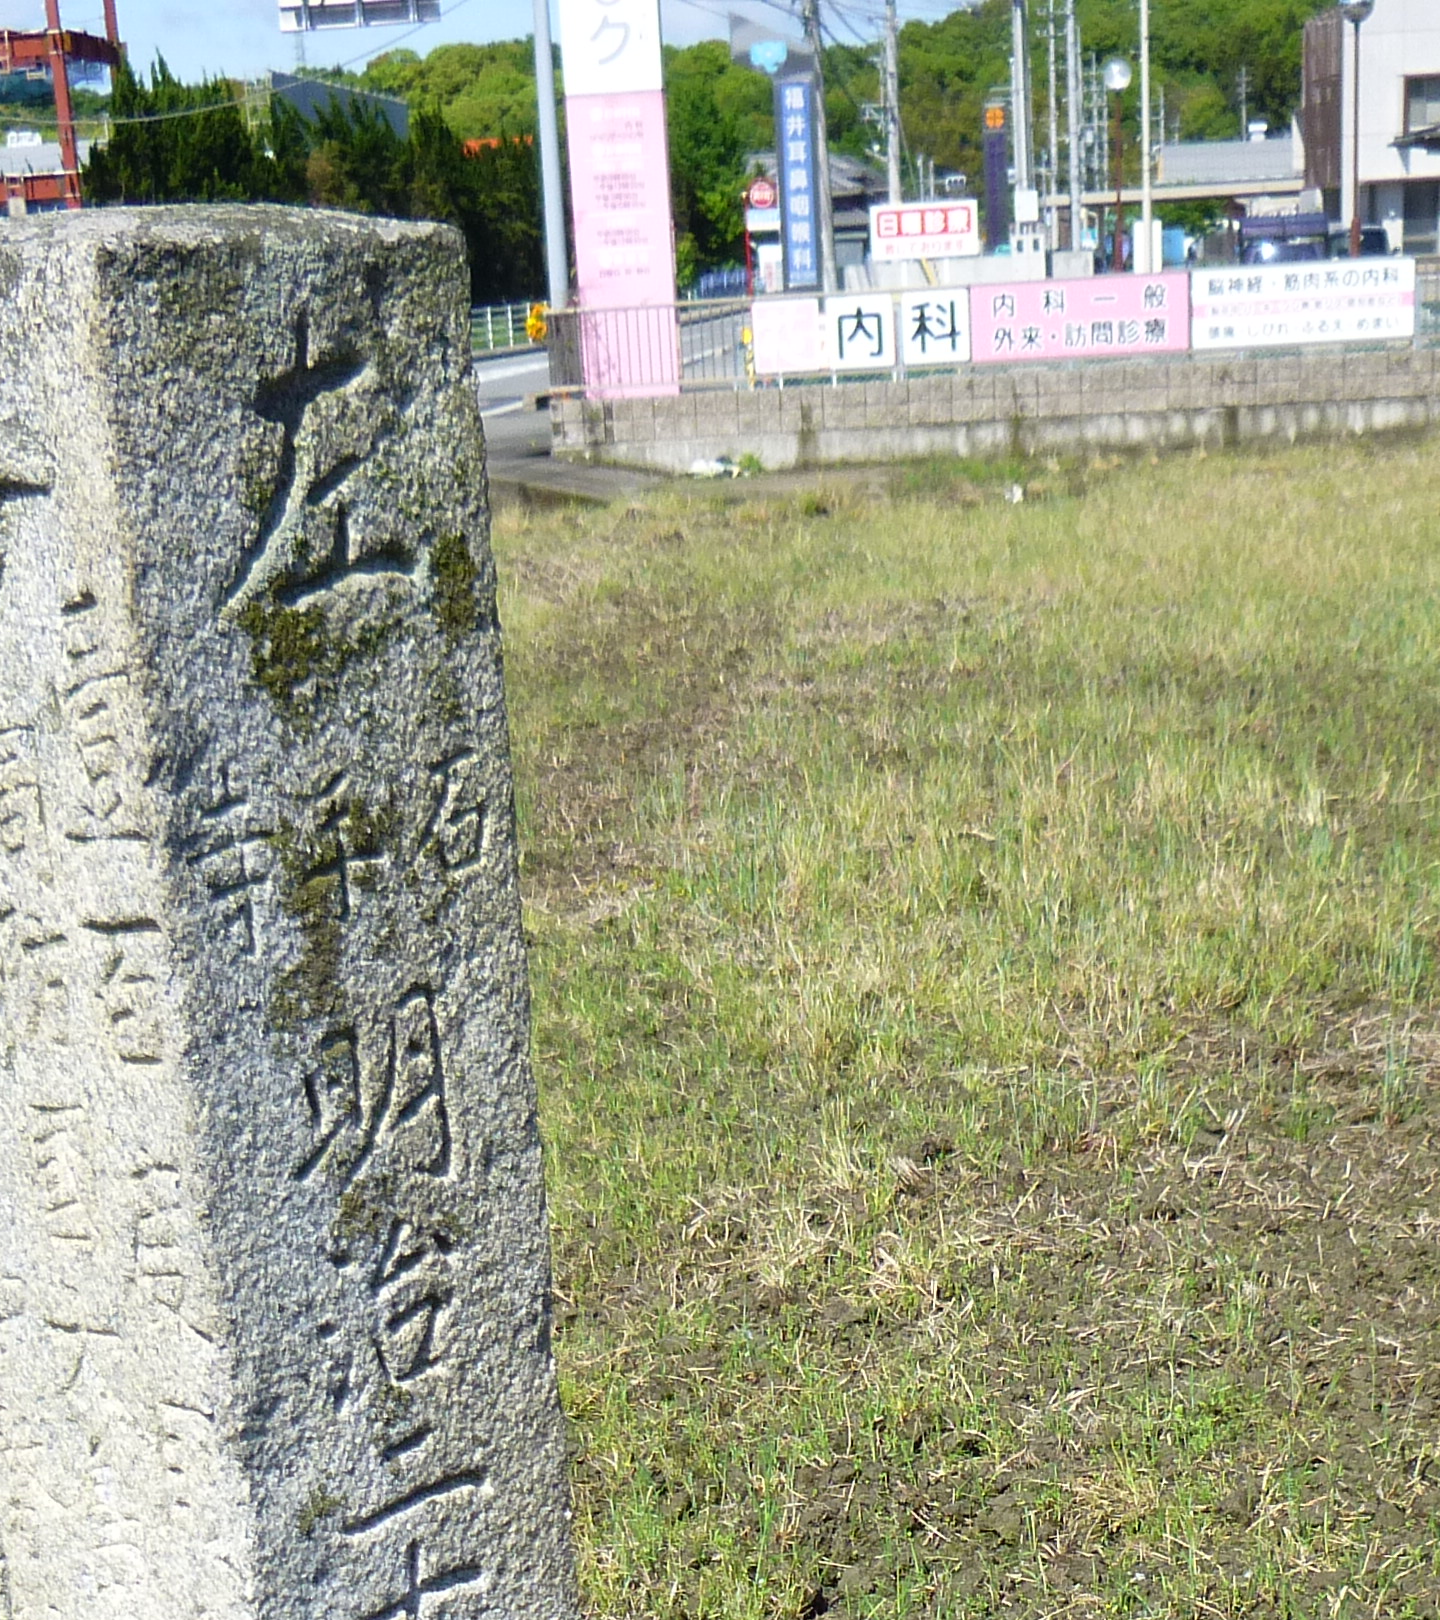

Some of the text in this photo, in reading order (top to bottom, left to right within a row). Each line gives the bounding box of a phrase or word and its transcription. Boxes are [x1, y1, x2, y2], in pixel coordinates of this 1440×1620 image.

[588, 0, 632, 66] ク
[992, 284, 1167, 318] 内科一般
[993, 318, 1168, 352] 外来・訪問診療
[225, 307, 417, 620] 左
